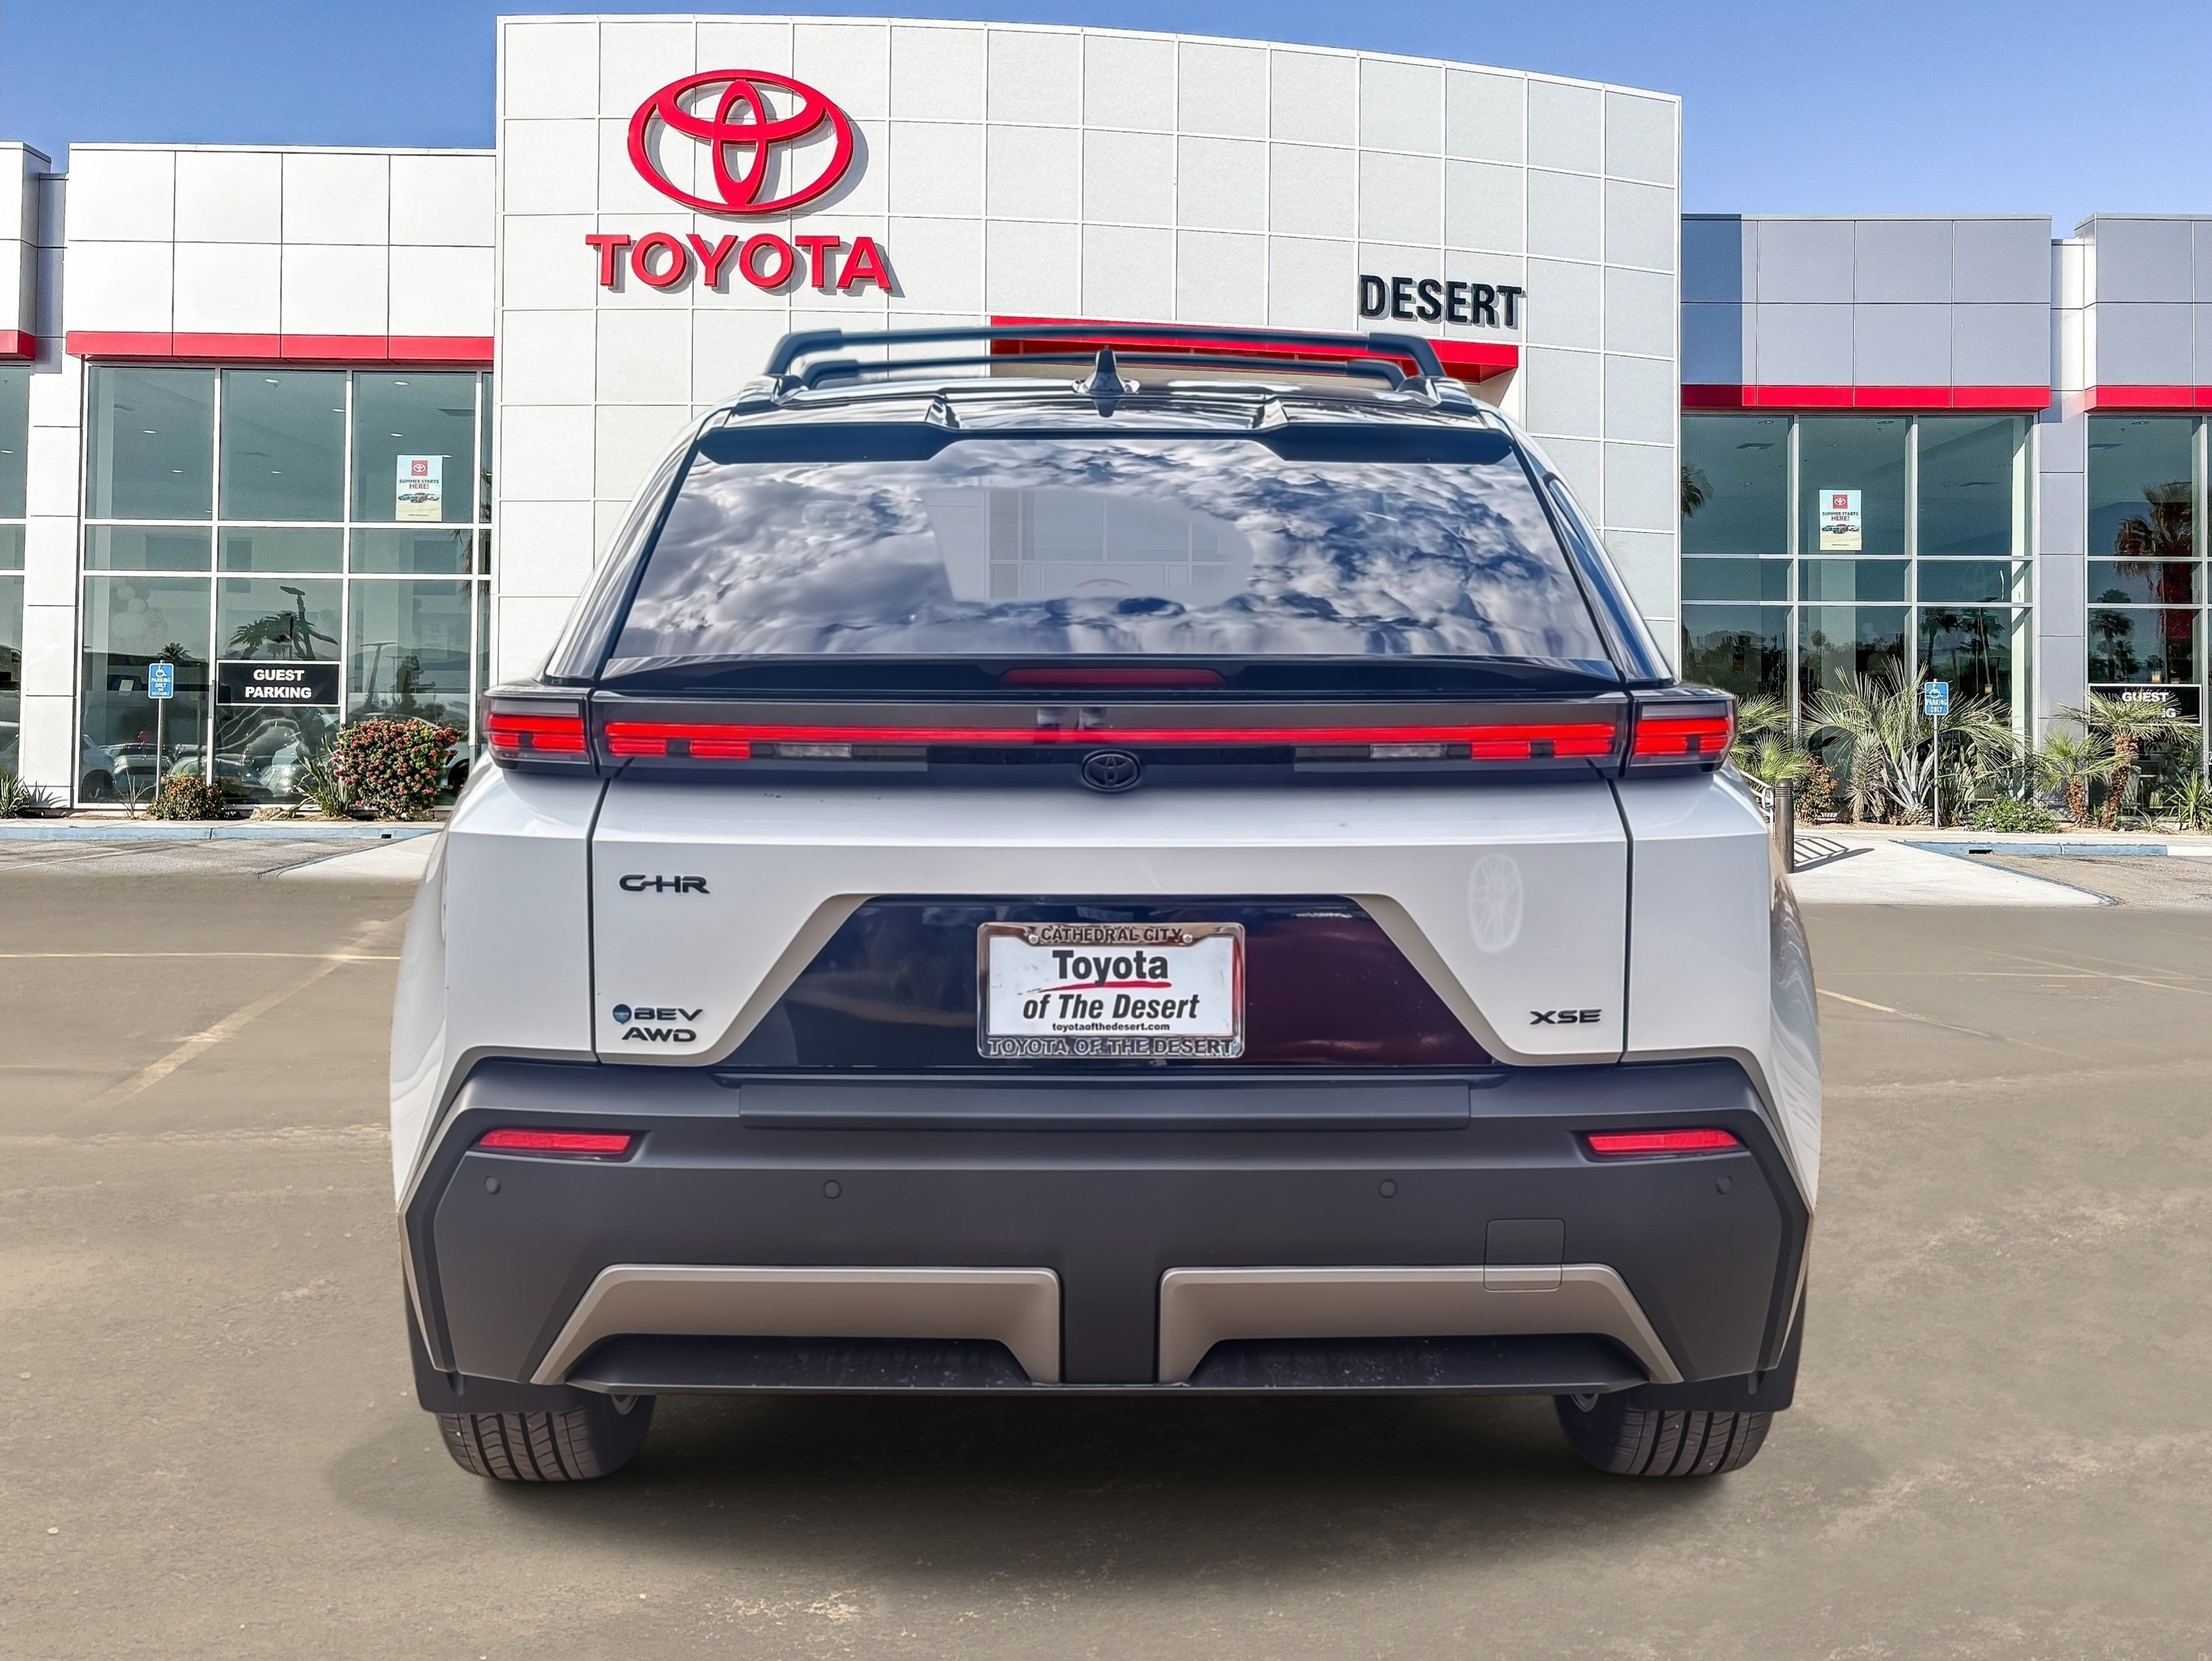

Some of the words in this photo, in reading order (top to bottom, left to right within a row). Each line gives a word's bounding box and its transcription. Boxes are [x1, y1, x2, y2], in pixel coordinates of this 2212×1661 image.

[585, 232, 893, 291] TOYOTA
[1359, 274, 1522, 327] DESERT
[253, 668, 305, 681] GUEST
[245, 686, 312, 699] PARKING
[2121, 691, 2170, 703] GUEST
[1041, 927, 1140, 942] CATHEDRAL
[1143, 928, 1183, 942] CITY
[1052, 950, 1169, 987] Toyota
[634, 1007, 703, 1021] BEV
[1023, 994, 1051, 1019] of
[1056, 995, 1103, 1019] The
[1112, 994, 1200, 1019] Desert
[1529, 1009, 1603, 1025] XSE
[621, 1027, 697, 1042] AWD
[1052, 1022, 1170, 1033] toyotaofthedesert.com
[987, 1038, 1068, 1056] TOYOTA
[1074, 1038, 1101, 1056] OF
[1107, 1038, 1150, 1056] THE
[1152, 1038, 1235, 1056] DESERT
